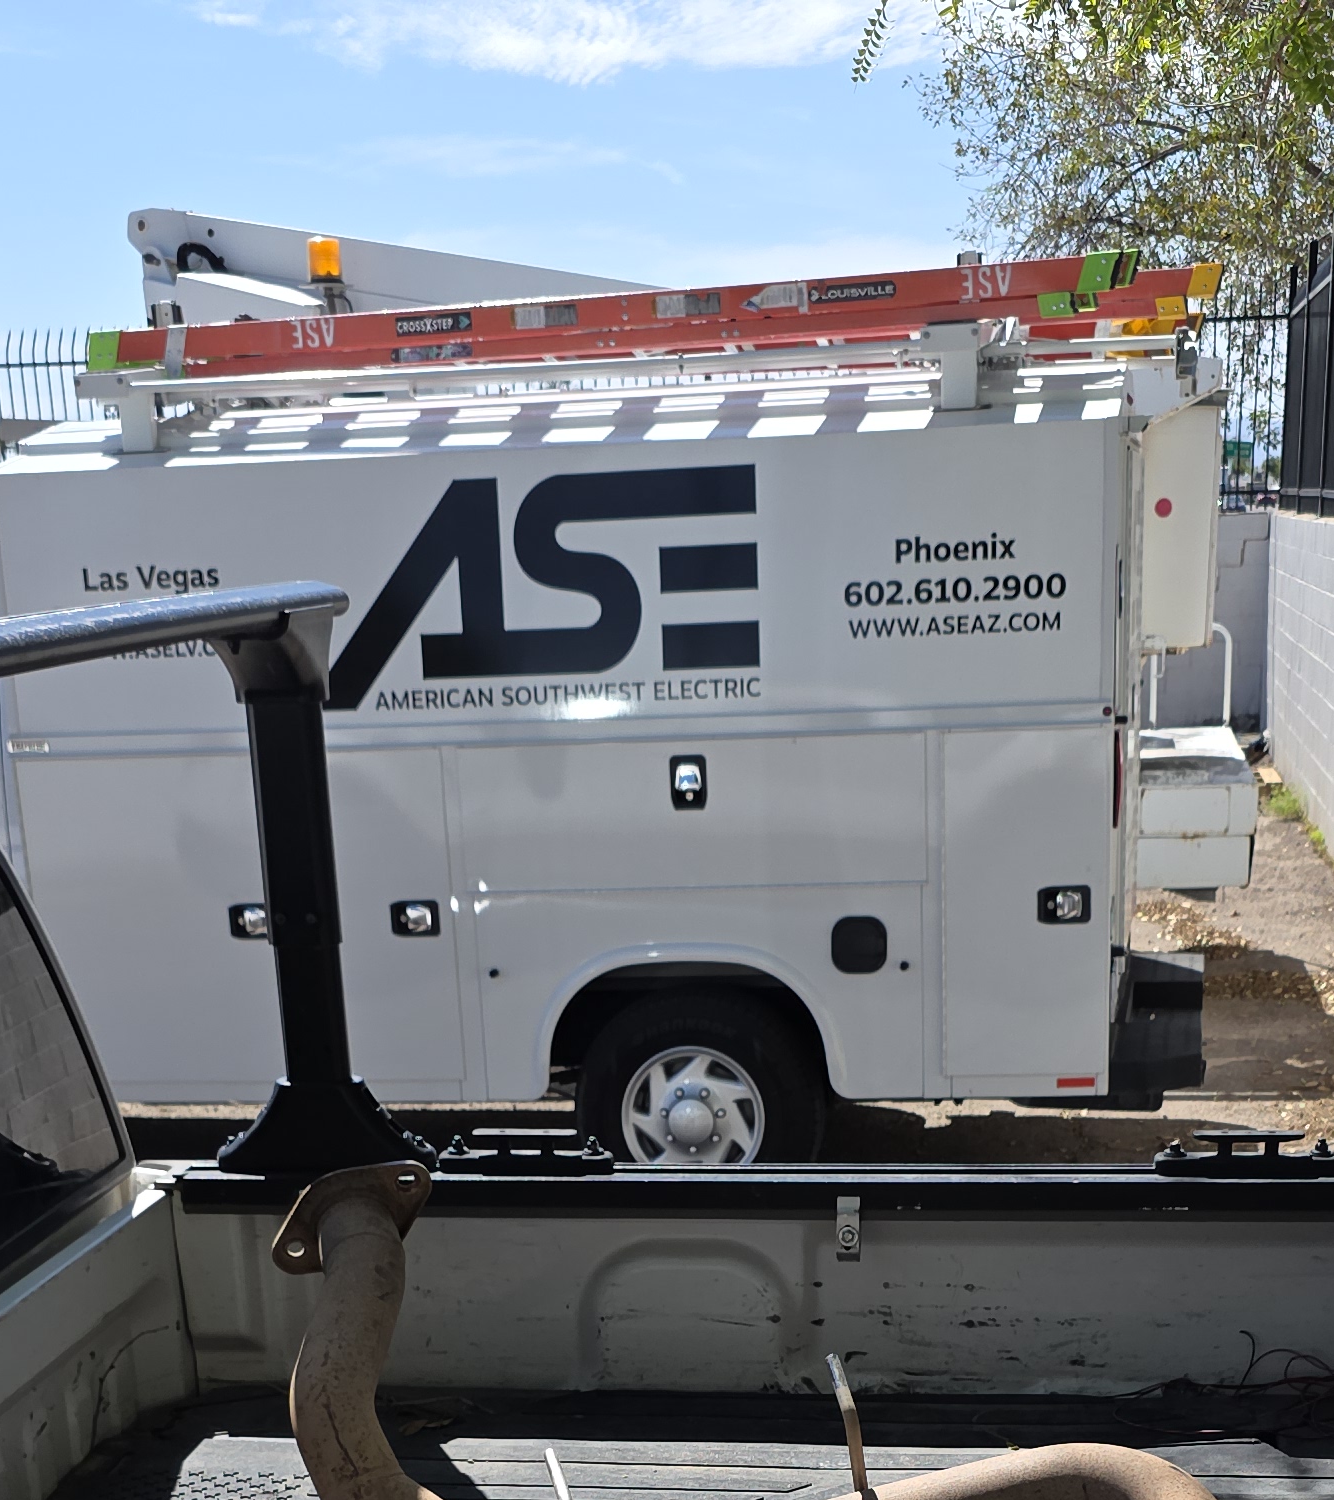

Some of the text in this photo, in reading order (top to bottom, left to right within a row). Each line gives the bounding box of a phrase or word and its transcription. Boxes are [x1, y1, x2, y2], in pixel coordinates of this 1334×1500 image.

[894, 532, 1016, 564] Phoenix
[82, 565, 220, 594] Las Vegas
[322, 464, 760, 711] ASE
[844, 573, 1067, 608] 602.610.2900
[848, 611, 1062, 639] WWW.ASEAZ.COM
[375, 677, 762, 711] AMERICAN SOUTHWEST ELECTRIC
